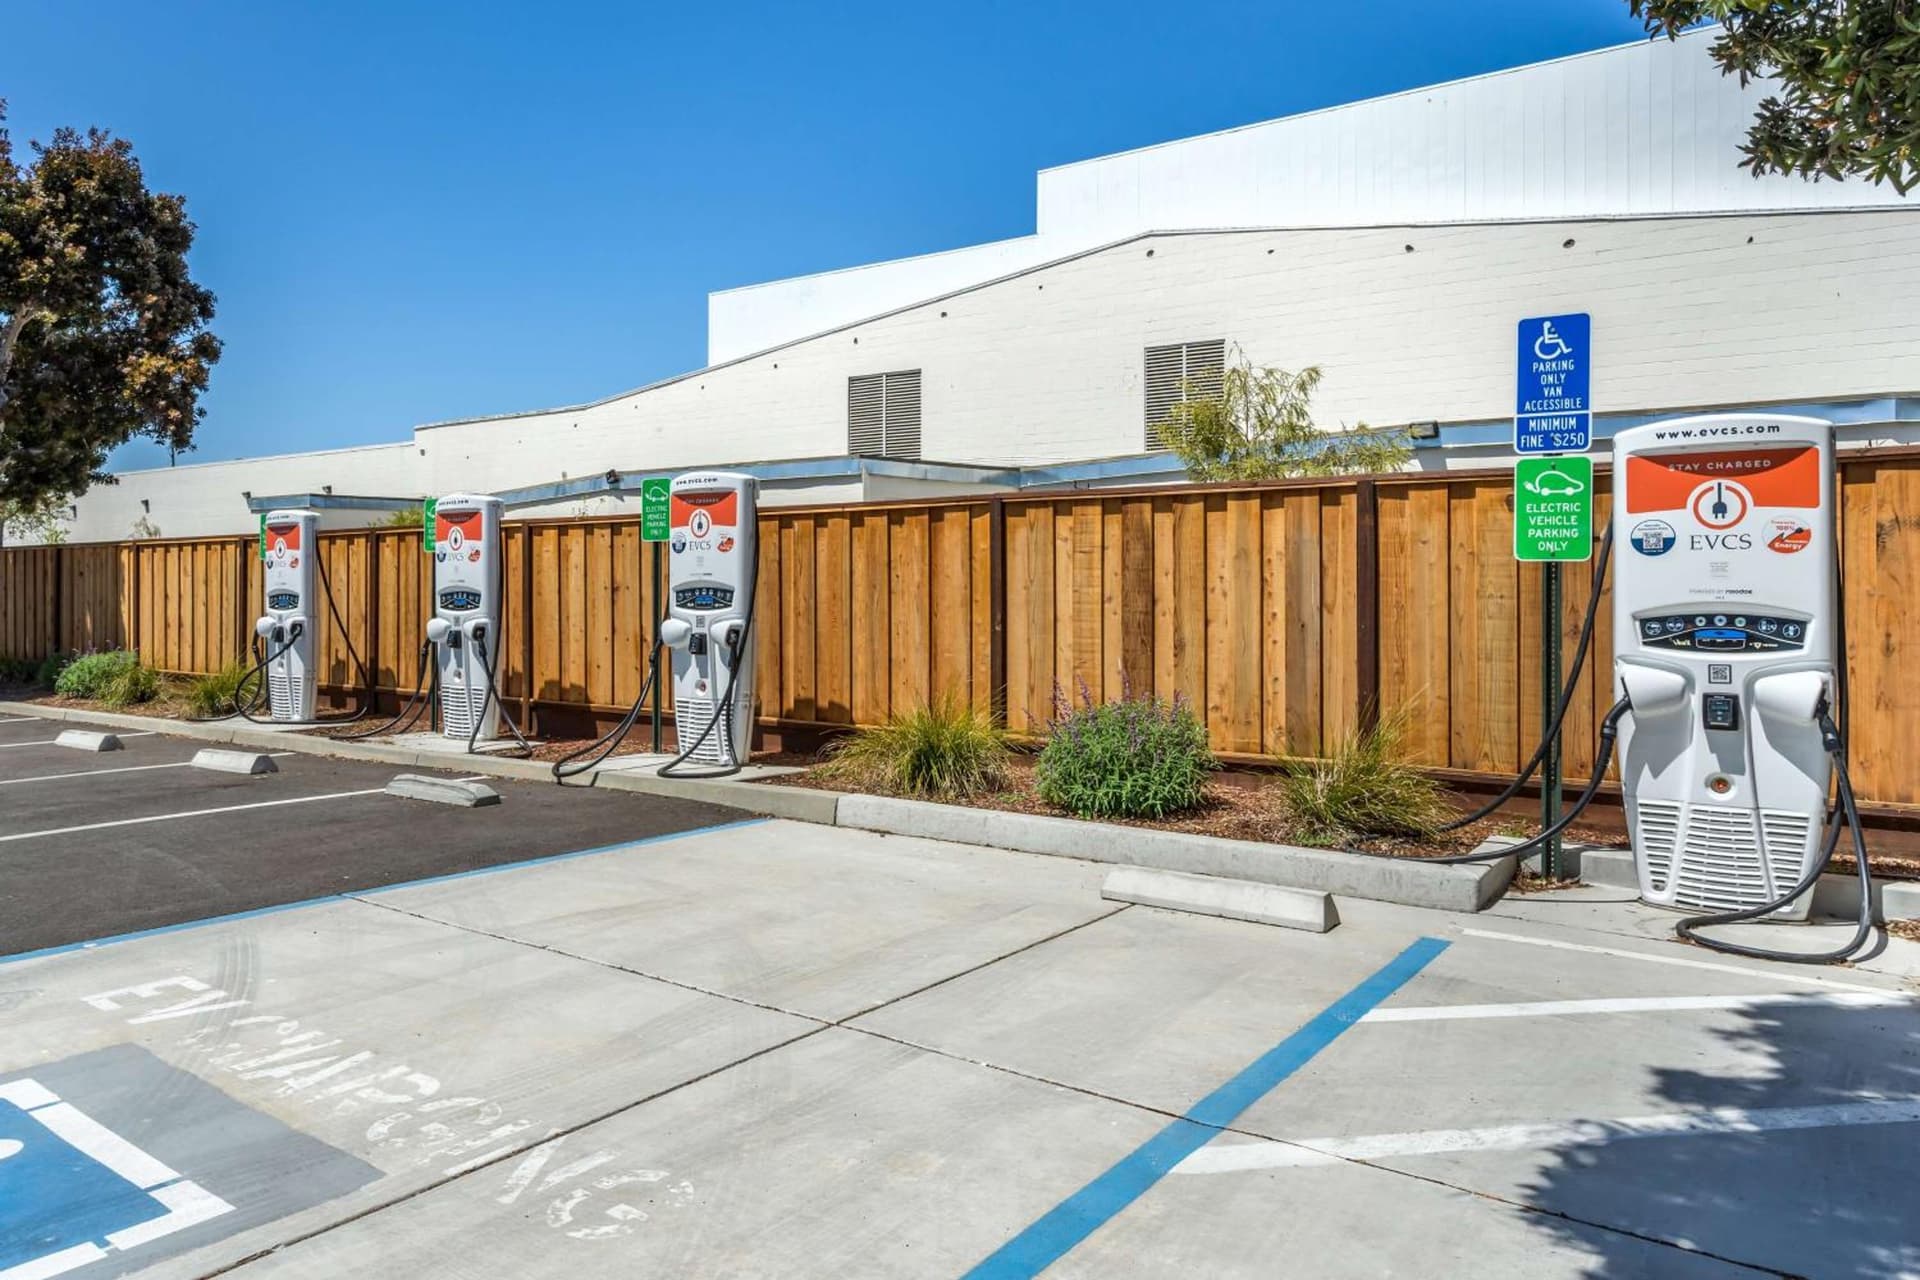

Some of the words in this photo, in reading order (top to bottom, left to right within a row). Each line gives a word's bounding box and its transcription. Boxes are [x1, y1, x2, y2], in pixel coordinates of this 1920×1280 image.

[1532, 360, 1575, 373] PARKING
[1540, 373, 1566, 385] ONLY
[1543, 386, 1562, 397] VAN
[1524, 398, 1582, 411] ACCESSIBLE
[1529, 416, 1577, 431] MINIMUM
[1656, 425, 1780, 440] www.evcs.com
[1520, 434, 1544, 448] FINE
[1553, 432, 1585, 447] $250
[1668, 463, 1700, 471] STAY
[1706, 460, 1772, 470] CHARGED
[1526, 503, 1581, 512] ELECTRIC
[1529, 515, 1578, 525] VEHICLE
[1528, 528, 1579, 538] PARKING
[1538, 541, 1568, 551] ONLY
[1690, 534, 1752, 550] EVCS
